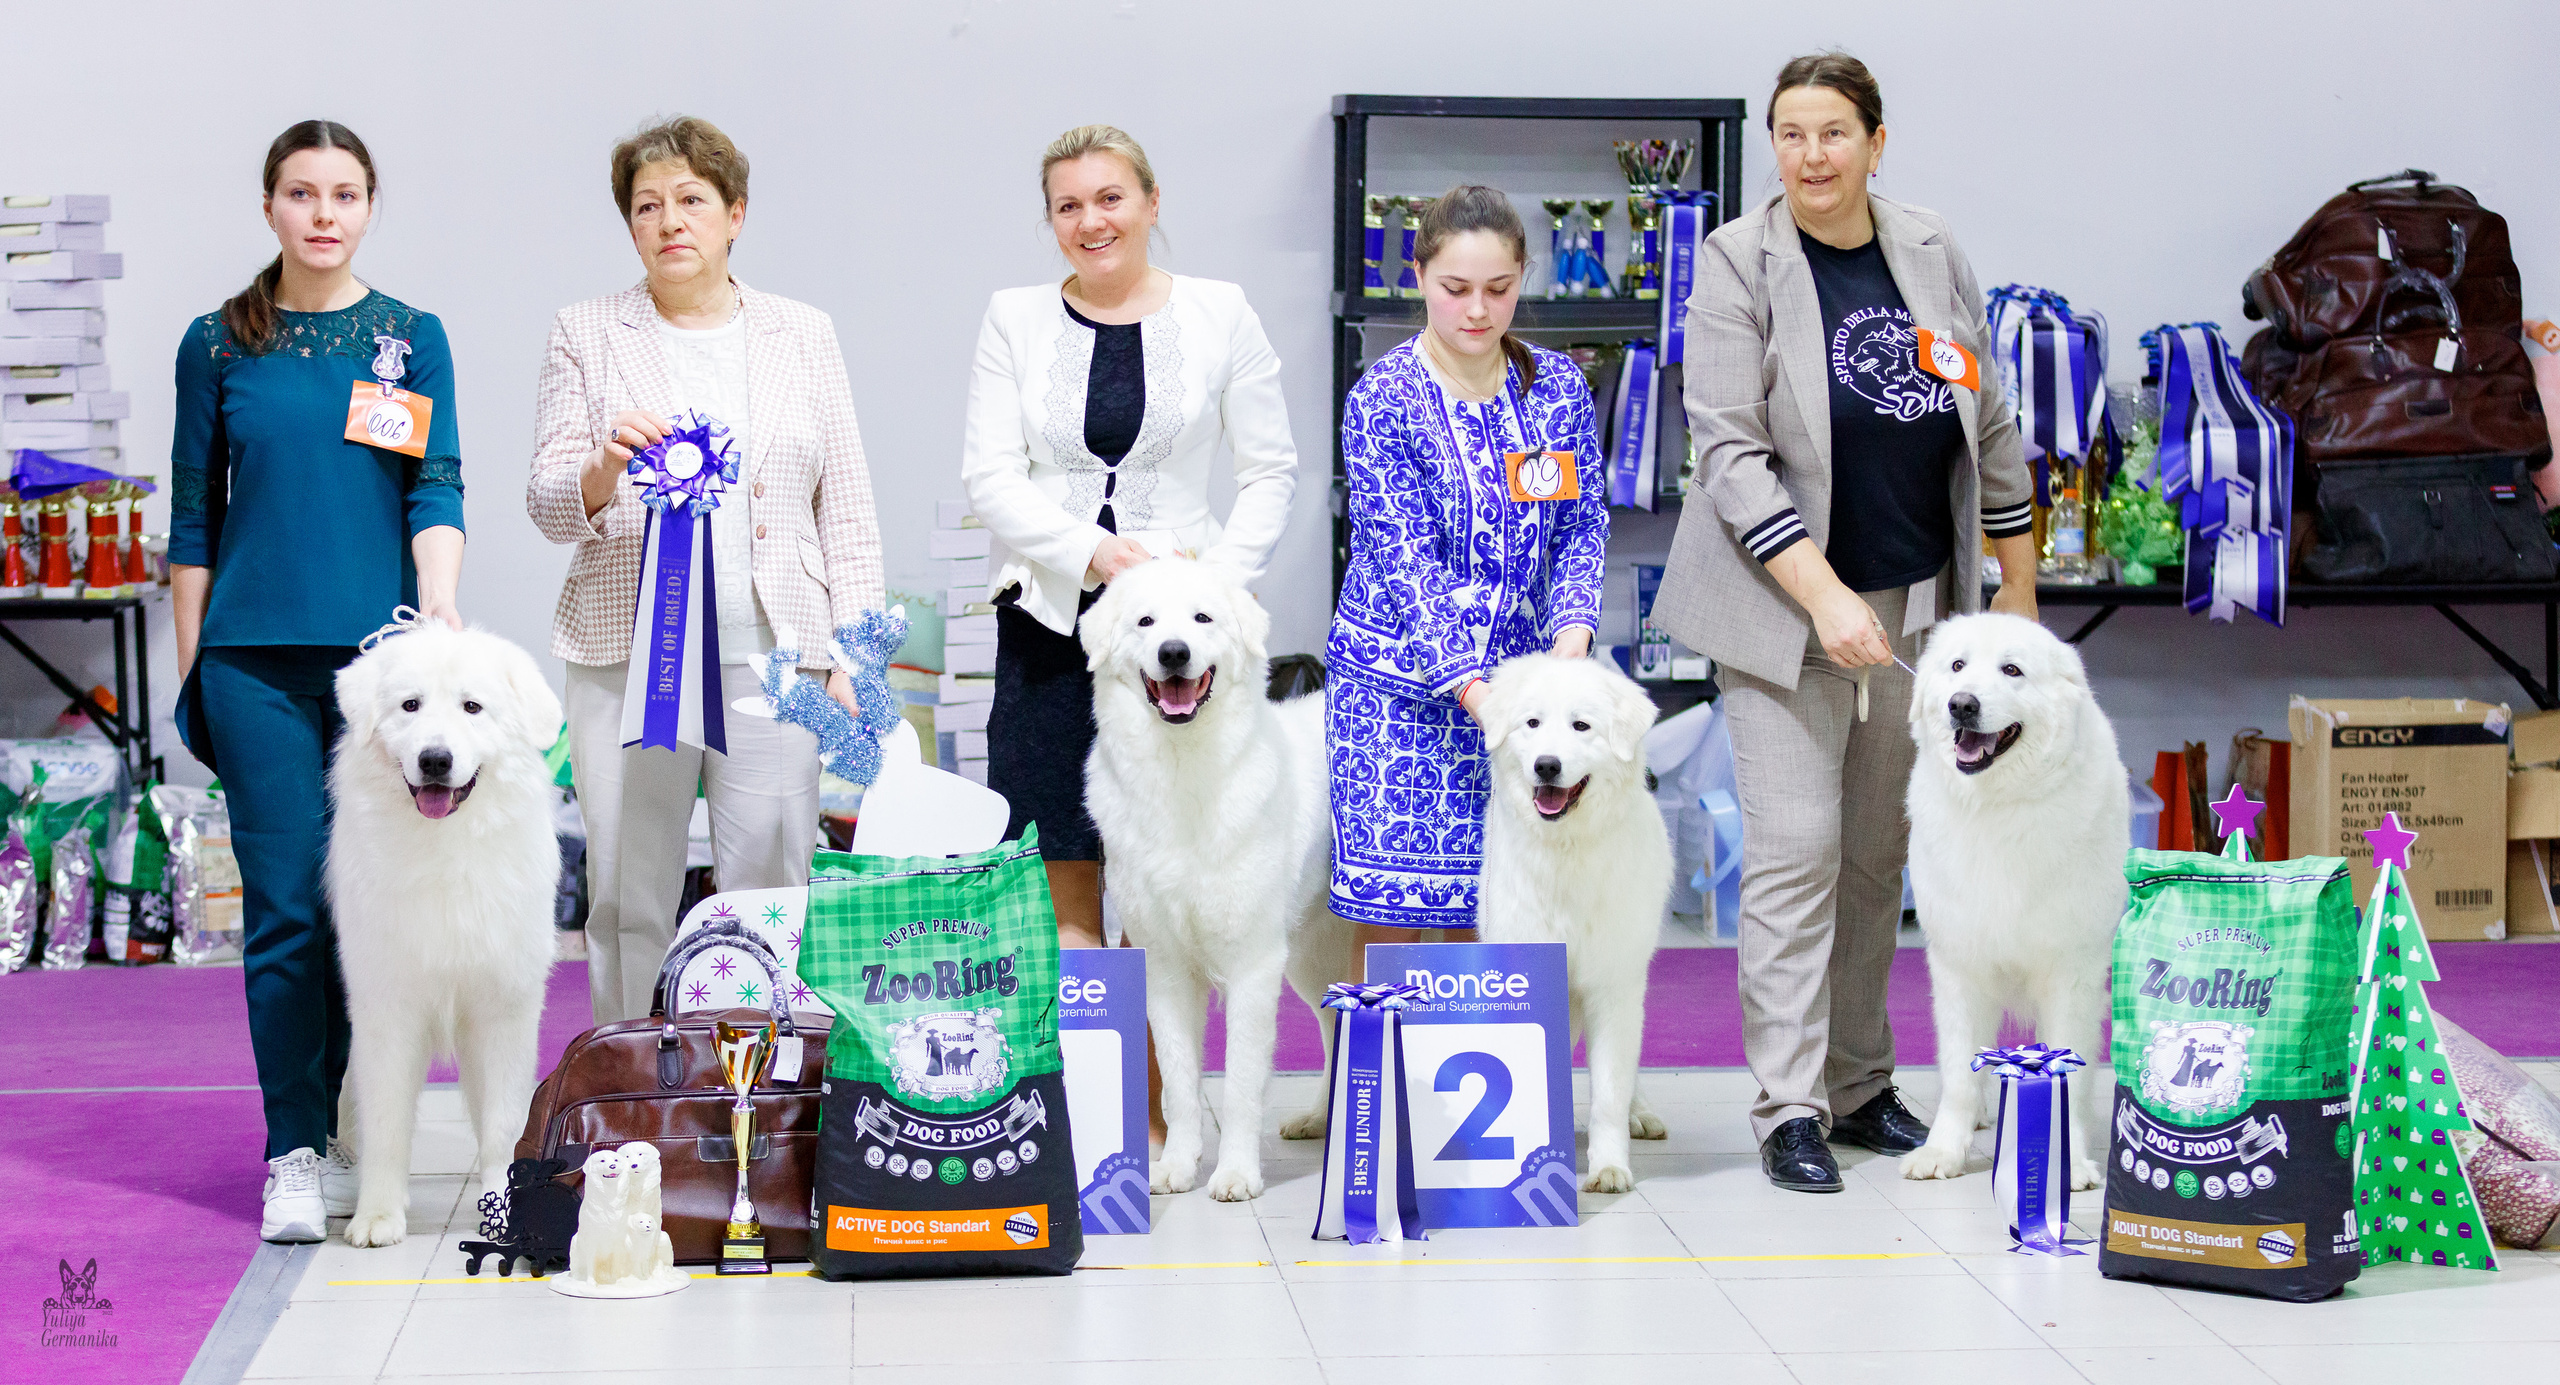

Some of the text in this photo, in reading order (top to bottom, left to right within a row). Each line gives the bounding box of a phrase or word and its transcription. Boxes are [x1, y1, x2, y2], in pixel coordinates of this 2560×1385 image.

[1832, 327, 1854, 384] SPIRITO
[1843, 306, 1891, 329] DELLA
[664, 576, 682, 626] BREED
[662, 629, 678, 651] OF
[659, 654, 676, 694] BEST
[2339, 728, 2415, 746] ENGY
[2341, 772, 2409, 783] Fan Heater
[2341, 786, 2426, 798] ENGY EN-507
[2341, 802, 2364, 813] Art:
[2341, 816, 2371, 828] Size:
[2340, 846, 2375, 858] Carto
[882, 918, 992, 951] SUPER PREMIUM
[2177, 927, 2272, 957] SUPER PREMIUM
[862, 953, 1020, 1006] ZooRing
[2139, 957, 2277, 1018] ZooRing
[1058, 1006, 1108, 1019] premium
[1449, 1000, 1531, 1014] Superpremium
[942, 1032, 975, 1043] ZooRing
[1433, 1051, 1515, 1161] 2
[901, 1117, 1002, 1144] DOG FOOD
[1353, 1087, 1373, 1187] BEST JUNIOR
[2145, 1128, 2233, 1157] DOG FOOD
[2026, 1157, 2039, 1218] VETERAN
[835, 1216, 991, 1234] ACTIVE DOG Standart
[1005, 1221, 1038, 1236] СТАНДАРТ
[2113, 1219, 2244, 1249] ADULT DOG Standart
[873, 1236, 903, 1245] Птичий
[933, 1238, 948, 1246] рис
[2258, 1239, 2295, 1255] СТАНДАРТ
